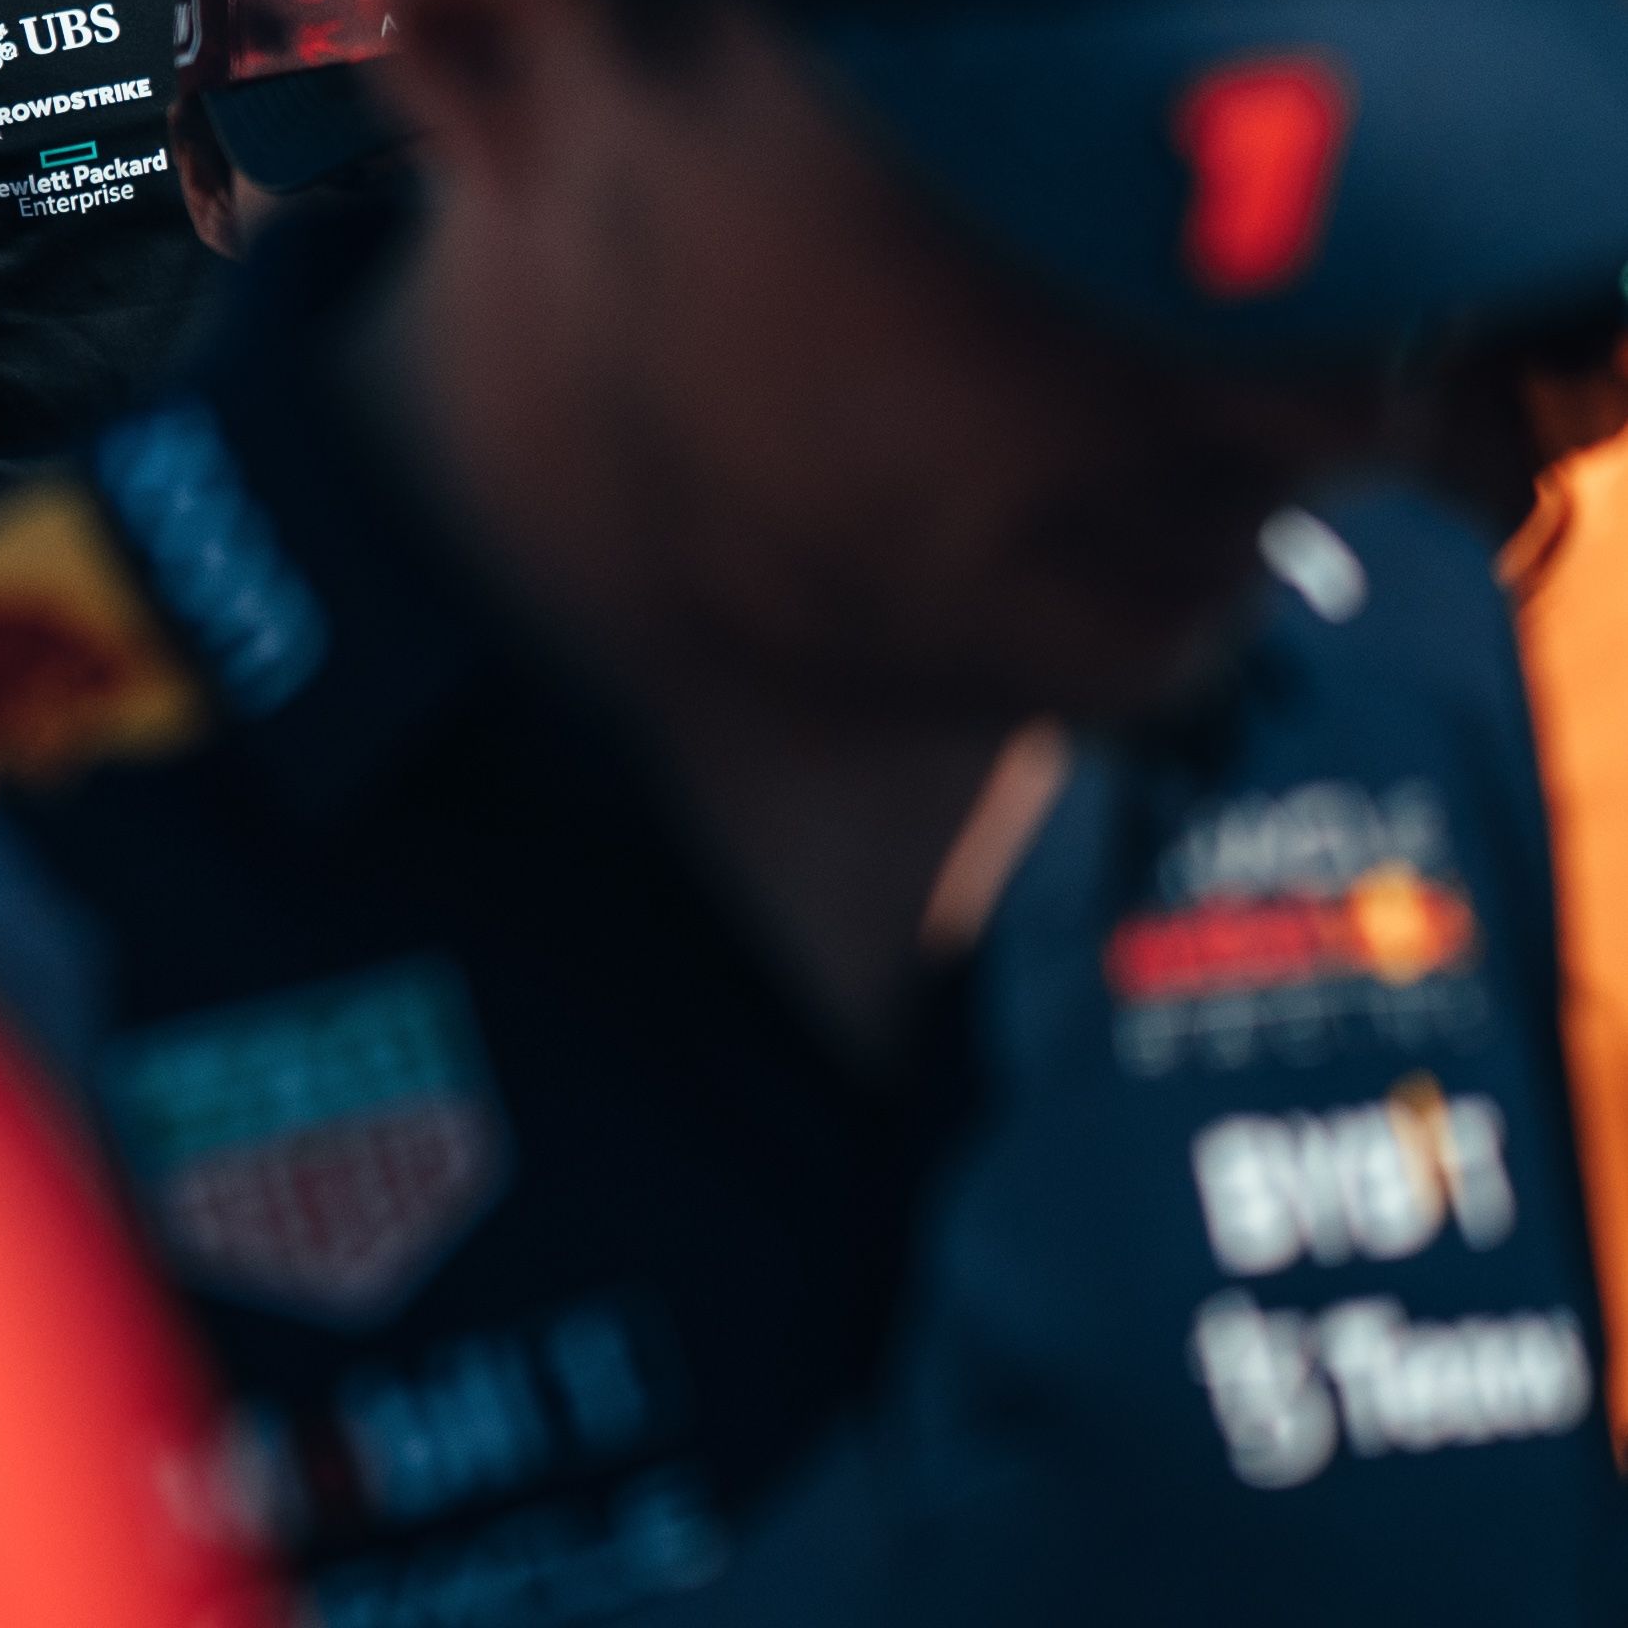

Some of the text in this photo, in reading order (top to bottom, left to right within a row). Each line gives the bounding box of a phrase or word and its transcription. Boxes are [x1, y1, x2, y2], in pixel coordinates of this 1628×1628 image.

[19, 3, 121, 55] UBS
[73, 148, 169, 188] Packard
[18, 183, 135, 218] Enterprise
